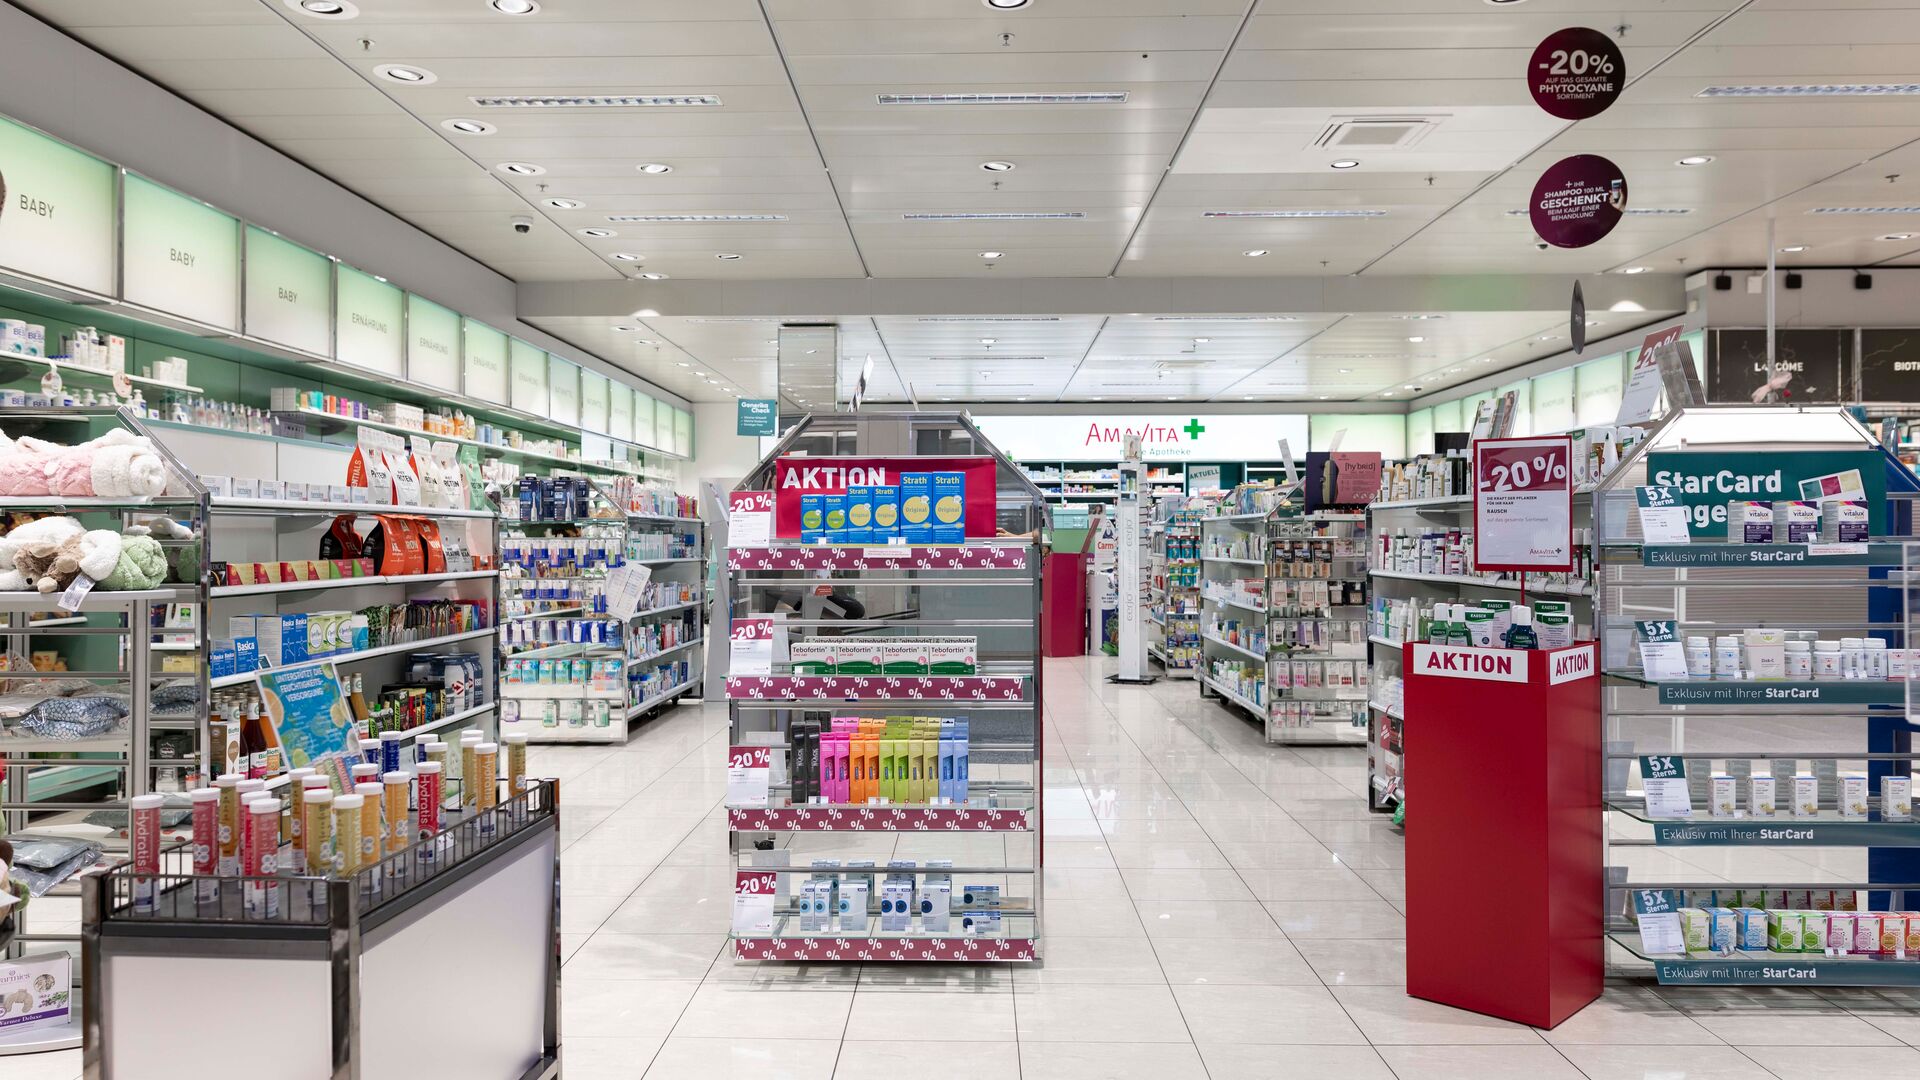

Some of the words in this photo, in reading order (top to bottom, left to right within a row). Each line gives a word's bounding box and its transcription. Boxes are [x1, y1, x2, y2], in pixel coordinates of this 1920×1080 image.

[1539, 49, 1614, 75] -20%
[1539, 83, 1614, 93] PHYTOCYANE
[1544, 188, 1582, 199] SHAMPOO
[20, 194, 55, 219] BABY
[1540, 192, 1609, 210] GESCHENKT
[1547, 208, 1563, 216] BEIM
[1563, 206, 1581, 214] KAUF
[1581, 204, 1600, 212] EINER
[170, 248, 195, 267] BABY
[278, 287, 298, 304] BABY
[1754, 360, 1804, 372] LACÔME
[1149, 448, 1191, 457] Apotheke
[782, 467, 886, 489] AKTION
[1190, 469, 1219, 480] AKTUELL
[903, 476, 928, 485] Strath
[935, 476, 961, 485] Strath
[1655, 470, 1781, 493] StarCard
[1649, 498, 1675, 507] Sterne
[1651, 551, 1696, 562] Exklusiv
[1700, 551, 1717, 561] mit
[1721, 551, 1747, 561] Ihrer
[1750, 551, 1804, 561] StarCard
[282, 619, 295, 627] Basica
[295, 618, 307, 626] Basica
[1648, 634, 1673, 643] Sterne
[237, 640, 255, 651] Basica
[1427, 652, 1511, 675] AKTION
[1556, 652, 1589, 677] AKTION
[1666, 688, 1711, 699] Exklusiv
[1715, 688, 1732, 698] mit
[1736, 688, 1763, 698] Ihrer
[1765, 688, 1819, 698] StarCard
[1652, 768, 1677, 778] Sterne
[420, 774, 430, 825] Hydratis
[137, 809, 150, 867] Hydratis
[1662, 829, 1706, 840] Exklusiv
[1710, 829, 1727, 839] mit
[1731, 829, 1758, 839] Ihrer
[1760, 829, 1814, 839] StarCard
[1646, 904, 1669, 914] Sterne
[1663, 967, 1709, 978] Exklusiv
[1712, 967, 1730, 978] mit
[1734, 967, 1760, 978] Ihrer
[1763, 967, 1817, 978] StarCard
